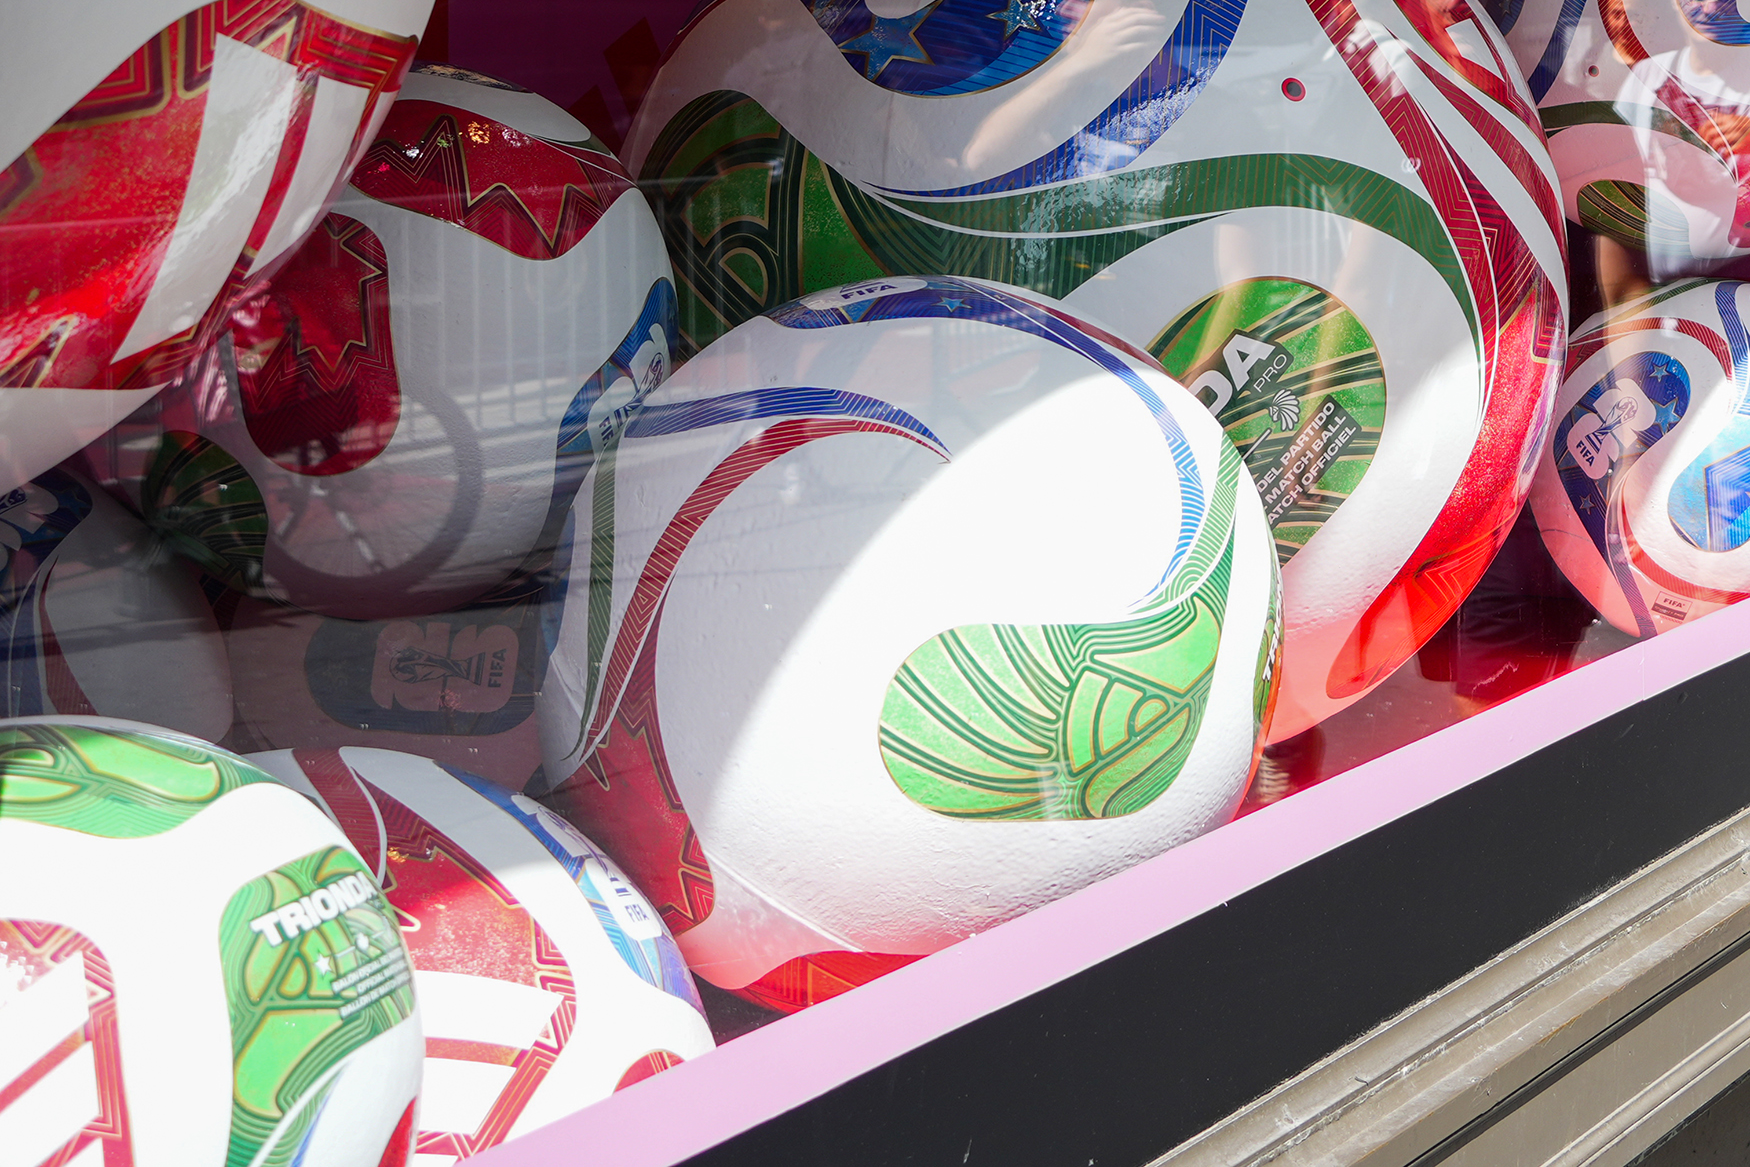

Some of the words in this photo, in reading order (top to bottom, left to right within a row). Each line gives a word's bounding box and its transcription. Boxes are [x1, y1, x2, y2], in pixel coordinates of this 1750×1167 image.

[841, 284, 898, 300] FIFA
[1253, 354, 1287, 393] PRO
[599, 416, 614, 447] FIF
[1257, 466, 1284, 493] DEL
[1280, 402, 1335, 466] PARTIDO
[1265, 452, 1314, 504] MATCH
[1312, 415, 1347, 453] BALL
[1576, 440, 1595, 467] FIFA
[1268, 485, 1303, 525] ATCH
[1301, 426, 1357, 487] OFFICIEL
[488, 648, 507, 688] FIFA
[249, 870, 379, 948] TRIONDA
[624, 904, 650, 923] FIFA
